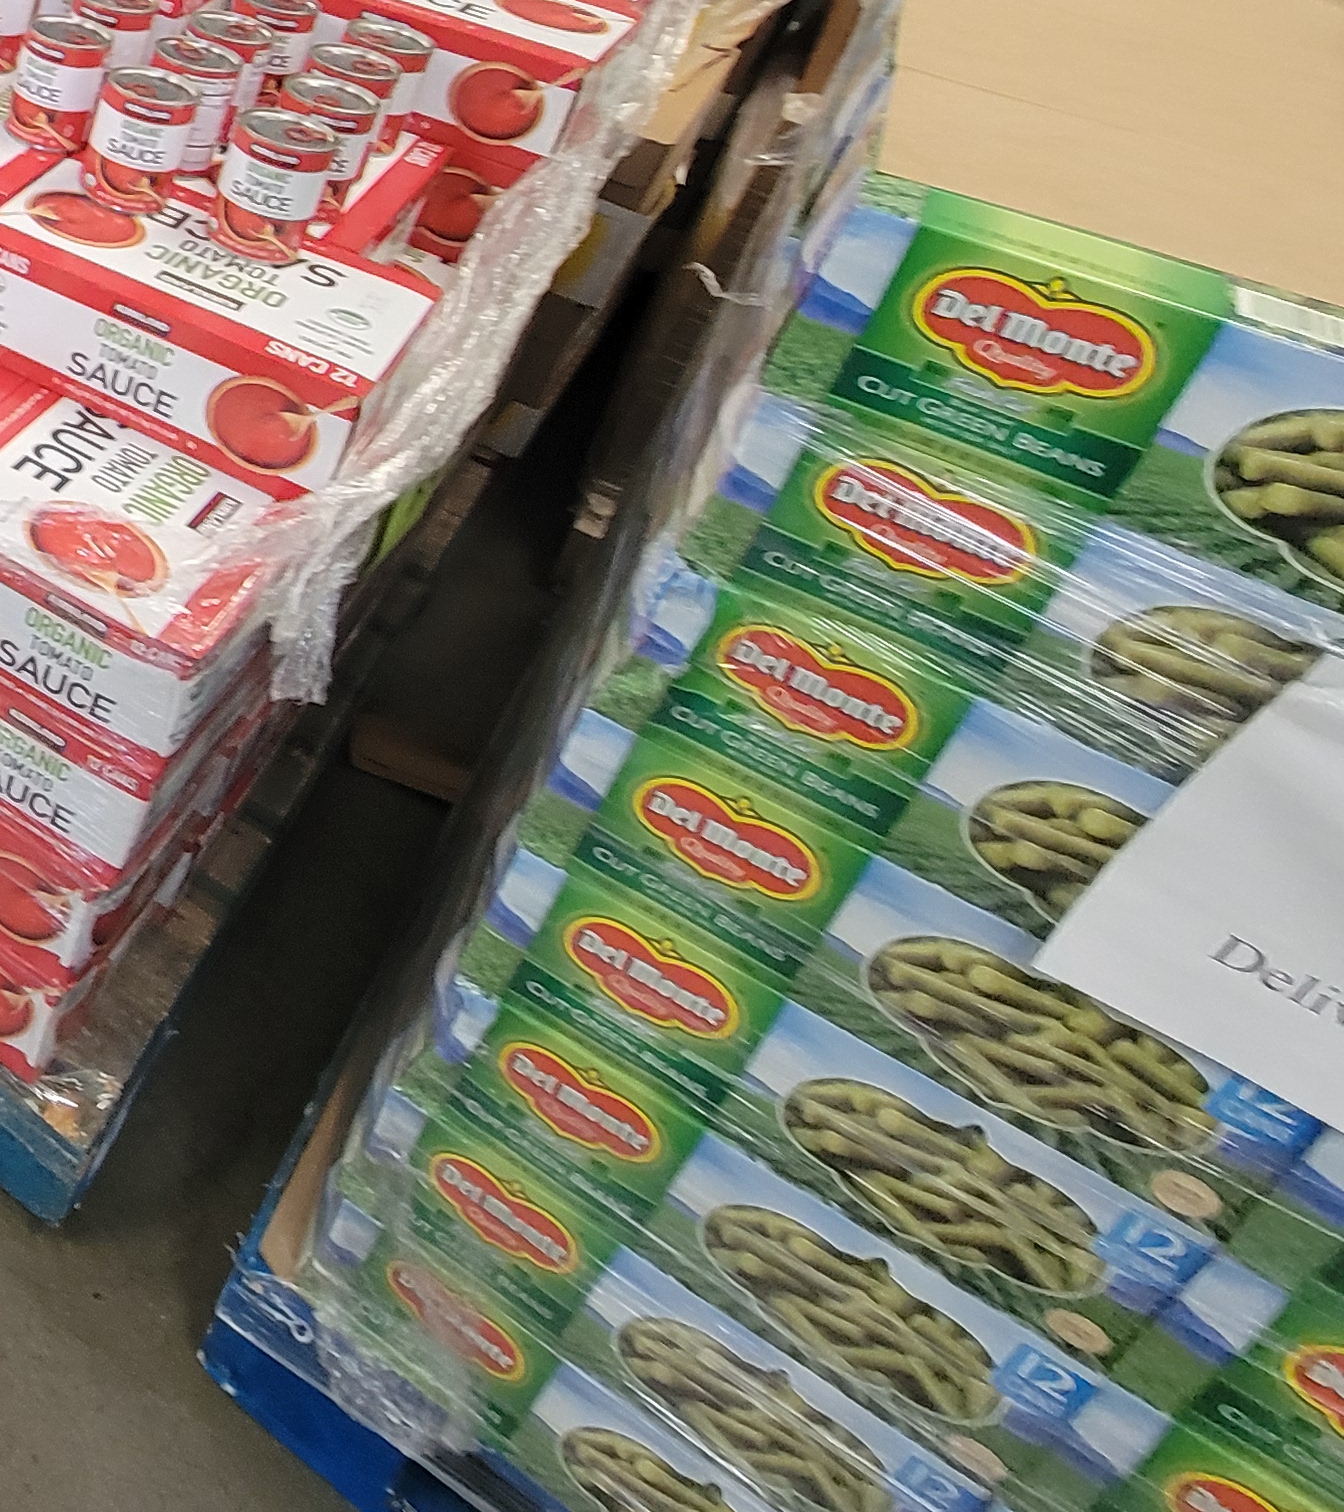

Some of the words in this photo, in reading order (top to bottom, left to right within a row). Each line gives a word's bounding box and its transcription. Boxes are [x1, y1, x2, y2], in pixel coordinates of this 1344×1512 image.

[144, 243, 290, 309] ORGANIC
[264, 339, 330, 375] CANS
[930, 288, 1003, 334] Del
[998, 311, 1141, 380] Monte
[66, 351, 179, 420] SAUCE
[857, 374, 918, 406] CUT
[11, 406, 119, 493] AUCE
[91, 441, 160, 494] TOMATO
[122, 454, 213, 527] ORGANIC
[25, 605, 114, 670] ORGANIC
[29, 633, 93, 682] TOMATO
[728, 639, 791, 682] Del
[787, 665, 905, 736] Monte
[670, 704, 721, 736] CUT
[592, 845, 642, 876] CUT
[646, 790, 703, 833] Del
[700, 818, 808, 889] Monte
[578, 928, 629, 971] Del
[1123, 1217, 1188, 1270] 12
[1017, 1352, 1078, 1403] 12
